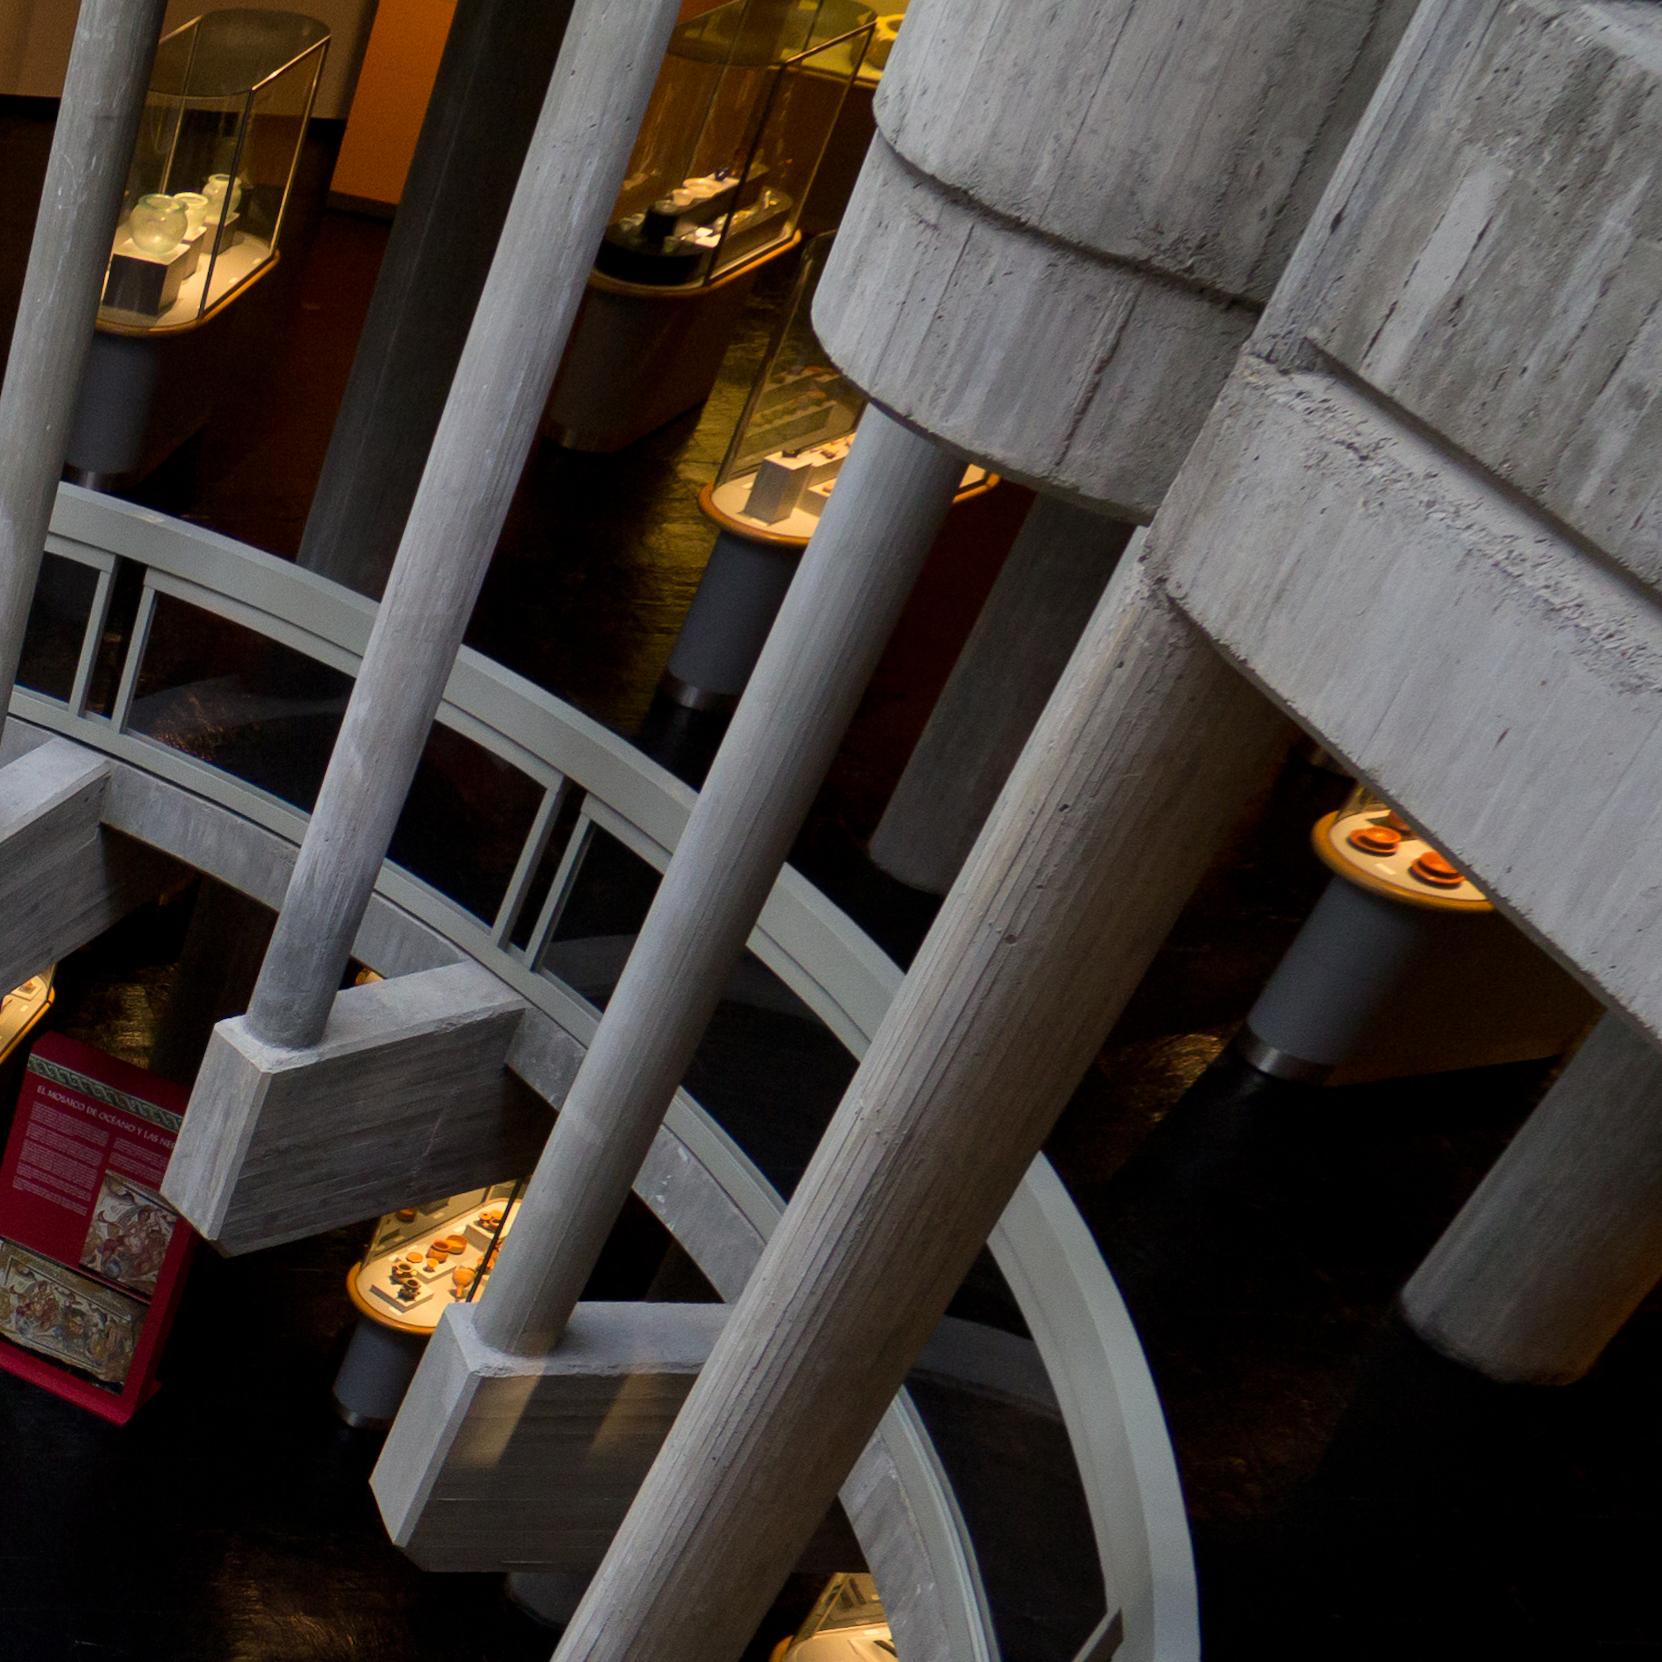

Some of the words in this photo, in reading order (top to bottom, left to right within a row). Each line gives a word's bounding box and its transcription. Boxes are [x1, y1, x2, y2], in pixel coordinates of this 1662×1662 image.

[37, 1085, 46, 1095] EL
[47, 1090, 86, 1111] MOSAICO
[86, 1105, 97, 1117] DE
[137, 1127, 143, 1135] Y
[143, 1130, 159, 1144] LAS
